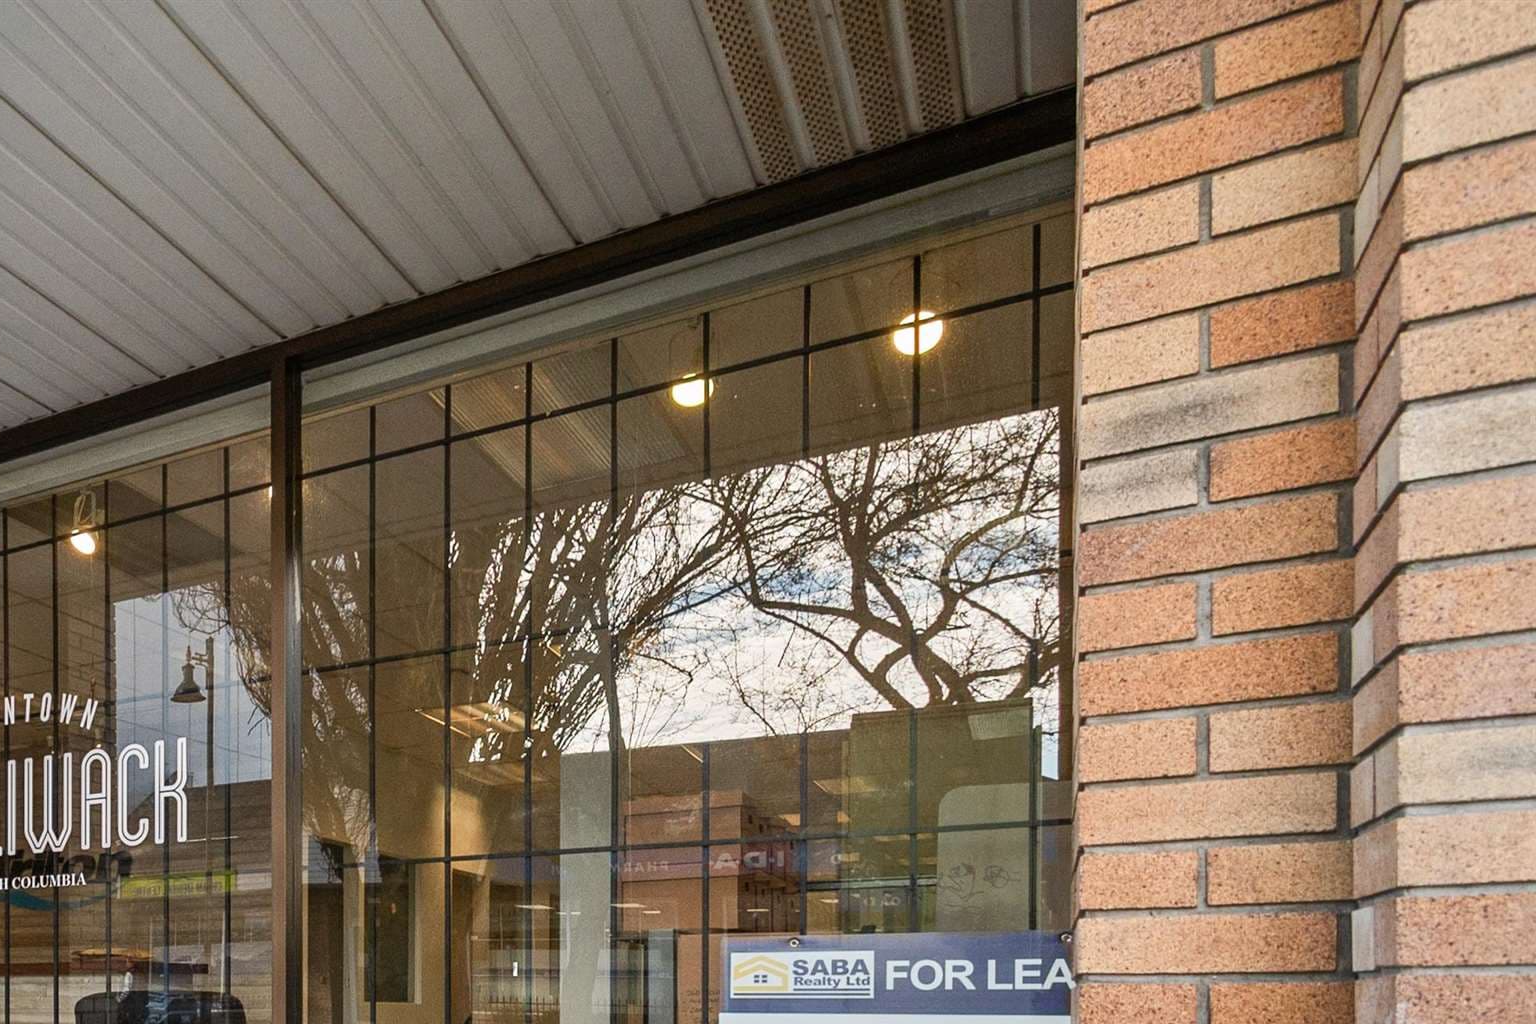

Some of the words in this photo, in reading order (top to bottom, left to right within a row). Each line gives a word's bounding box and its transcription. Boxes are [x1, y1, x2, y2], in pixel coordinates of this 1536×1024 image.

[11, 872, 87, 890] COLUMBIA
[792, 958, 870, 976] SABA
[885, 958, 977, 991] FOR
[793, 976, 841, 990] Realty
[846, 975, 871, 987] Ltd
